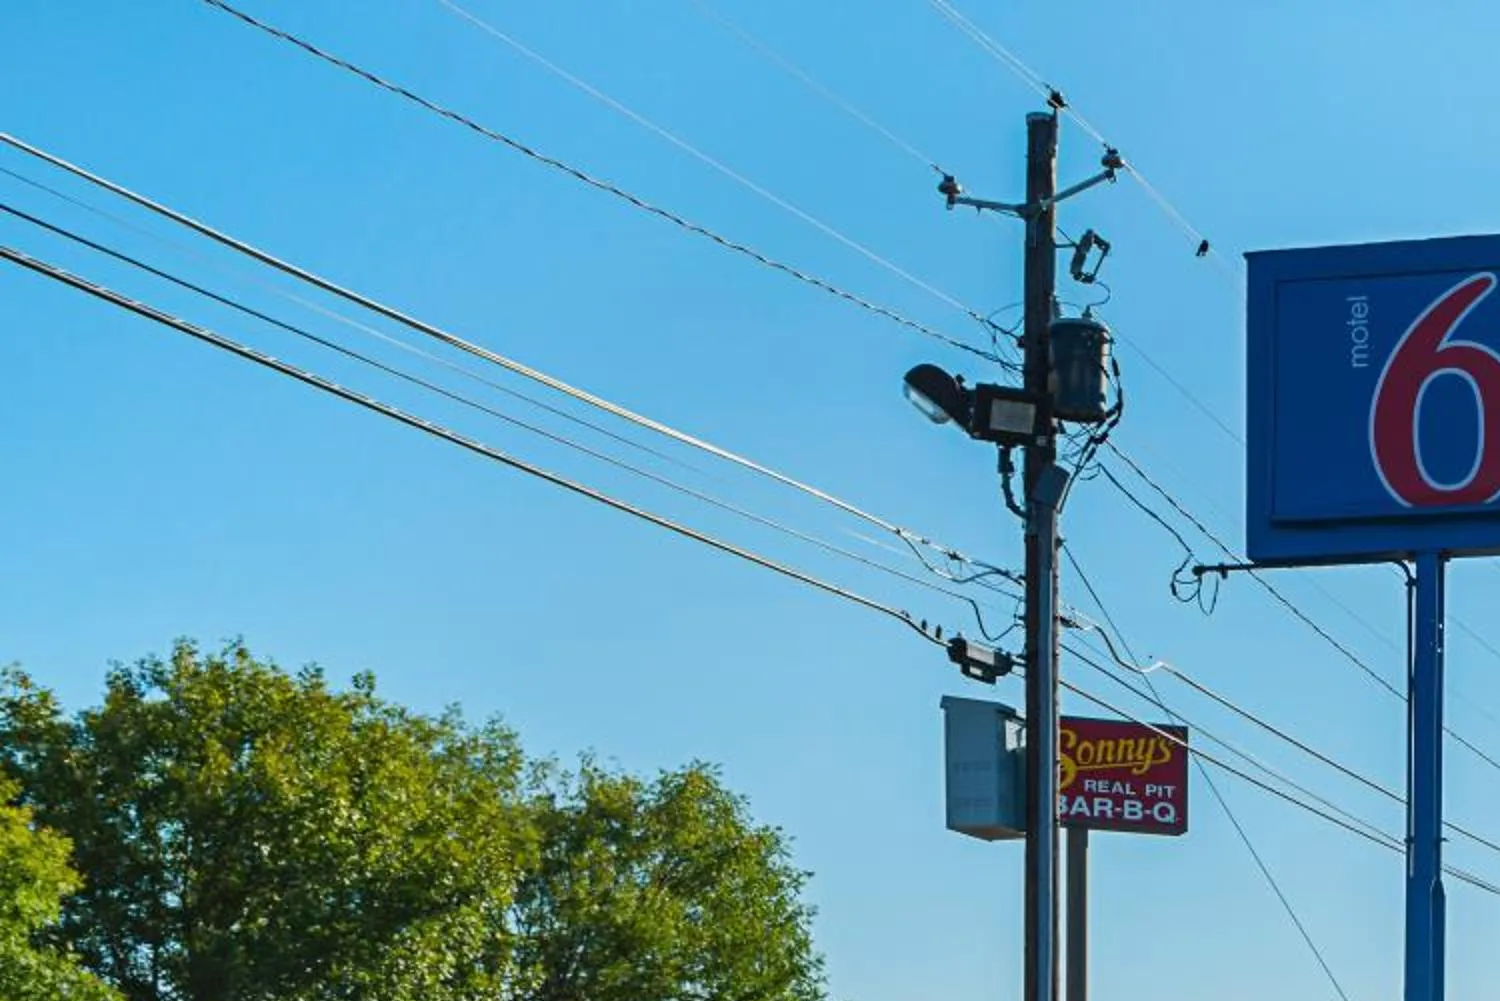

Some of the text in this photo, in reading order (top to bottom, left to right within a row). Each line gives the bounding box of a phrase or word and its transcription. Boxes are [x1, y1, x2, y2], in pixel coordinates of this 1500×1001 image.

[1345, 295, 1370, 368] motel
[1084, 779, 1177, 799] REAL PIT
